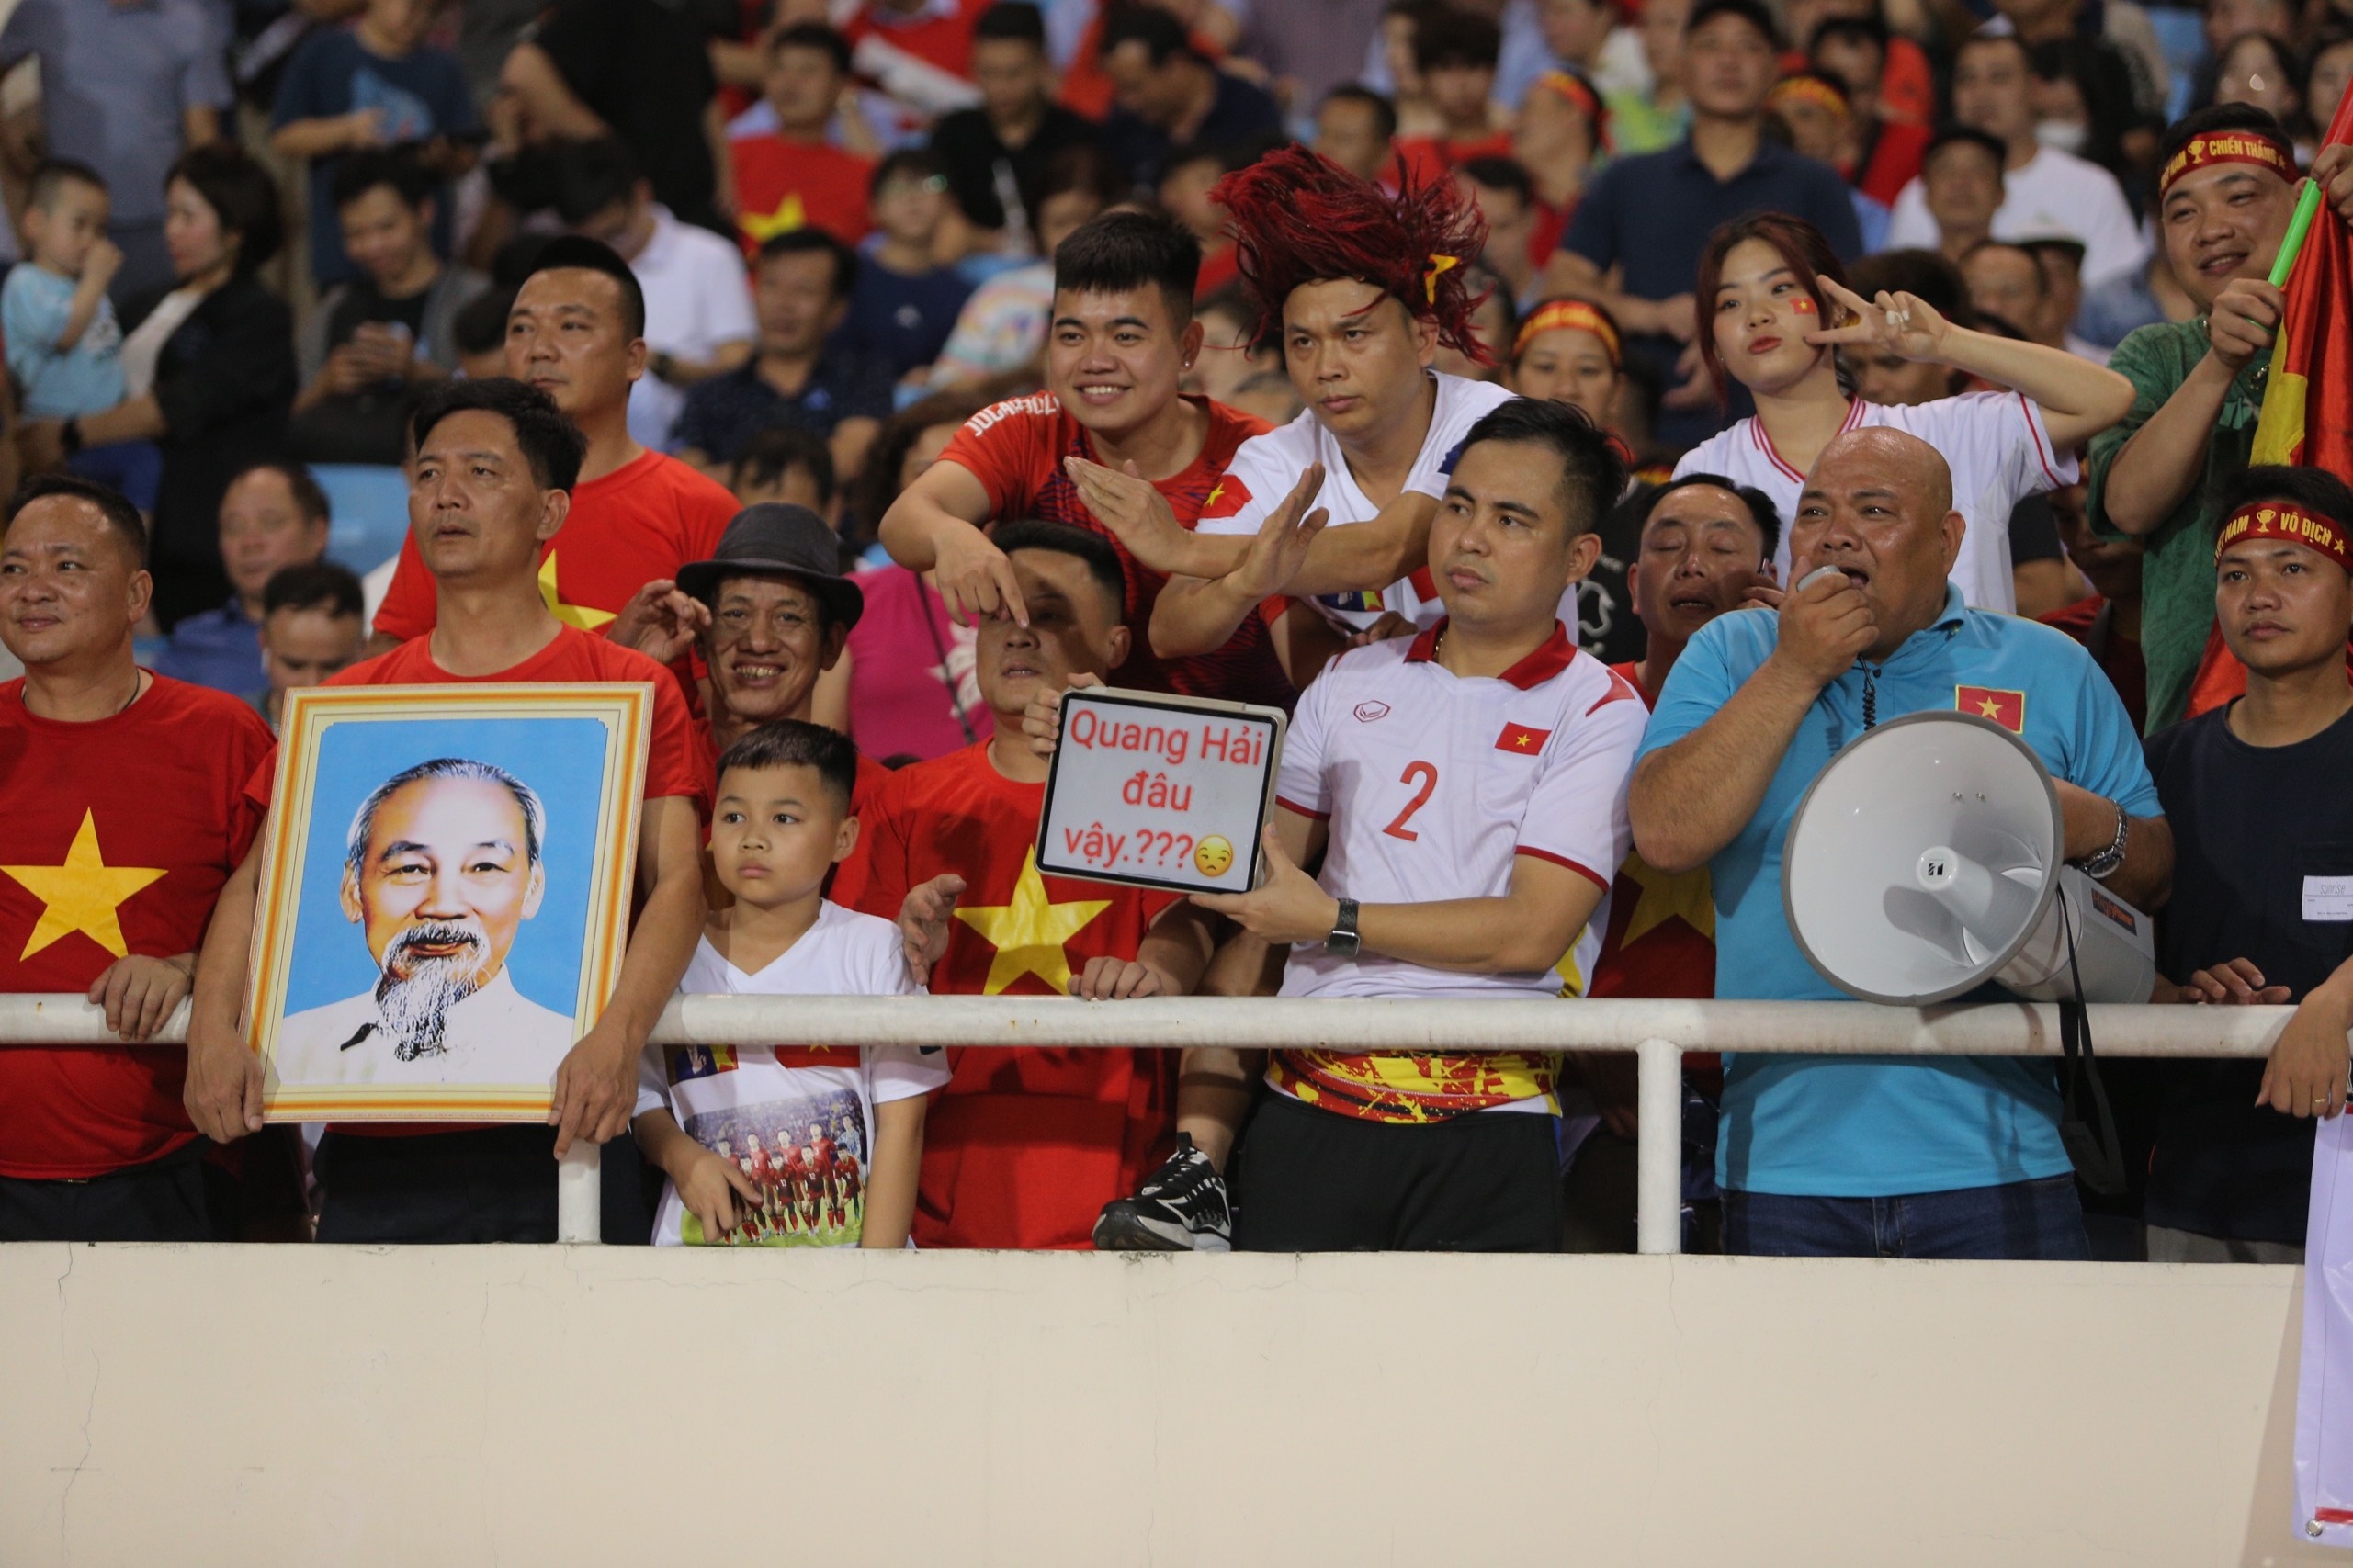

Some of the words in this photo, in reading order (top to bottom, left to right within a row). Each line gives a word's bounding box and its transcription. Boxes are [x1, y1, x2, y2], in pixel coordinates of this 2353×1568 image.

[2209, 136, 2243, 156] CHIẾN
[2224, 514, 2250, 543] NAM
[2280, 511, 2299, 533] VÔ
[2301, 517, 2333, 547] ĐỊCH
[1070, 708, 1189, 765] Quang
[1200, 725, 1263, 766] Hải
[1122, 770, 1192, 812] đâu
[1382, 760, 1438, 842] 2
[1064, 821, 1193, 869] vậy.???
